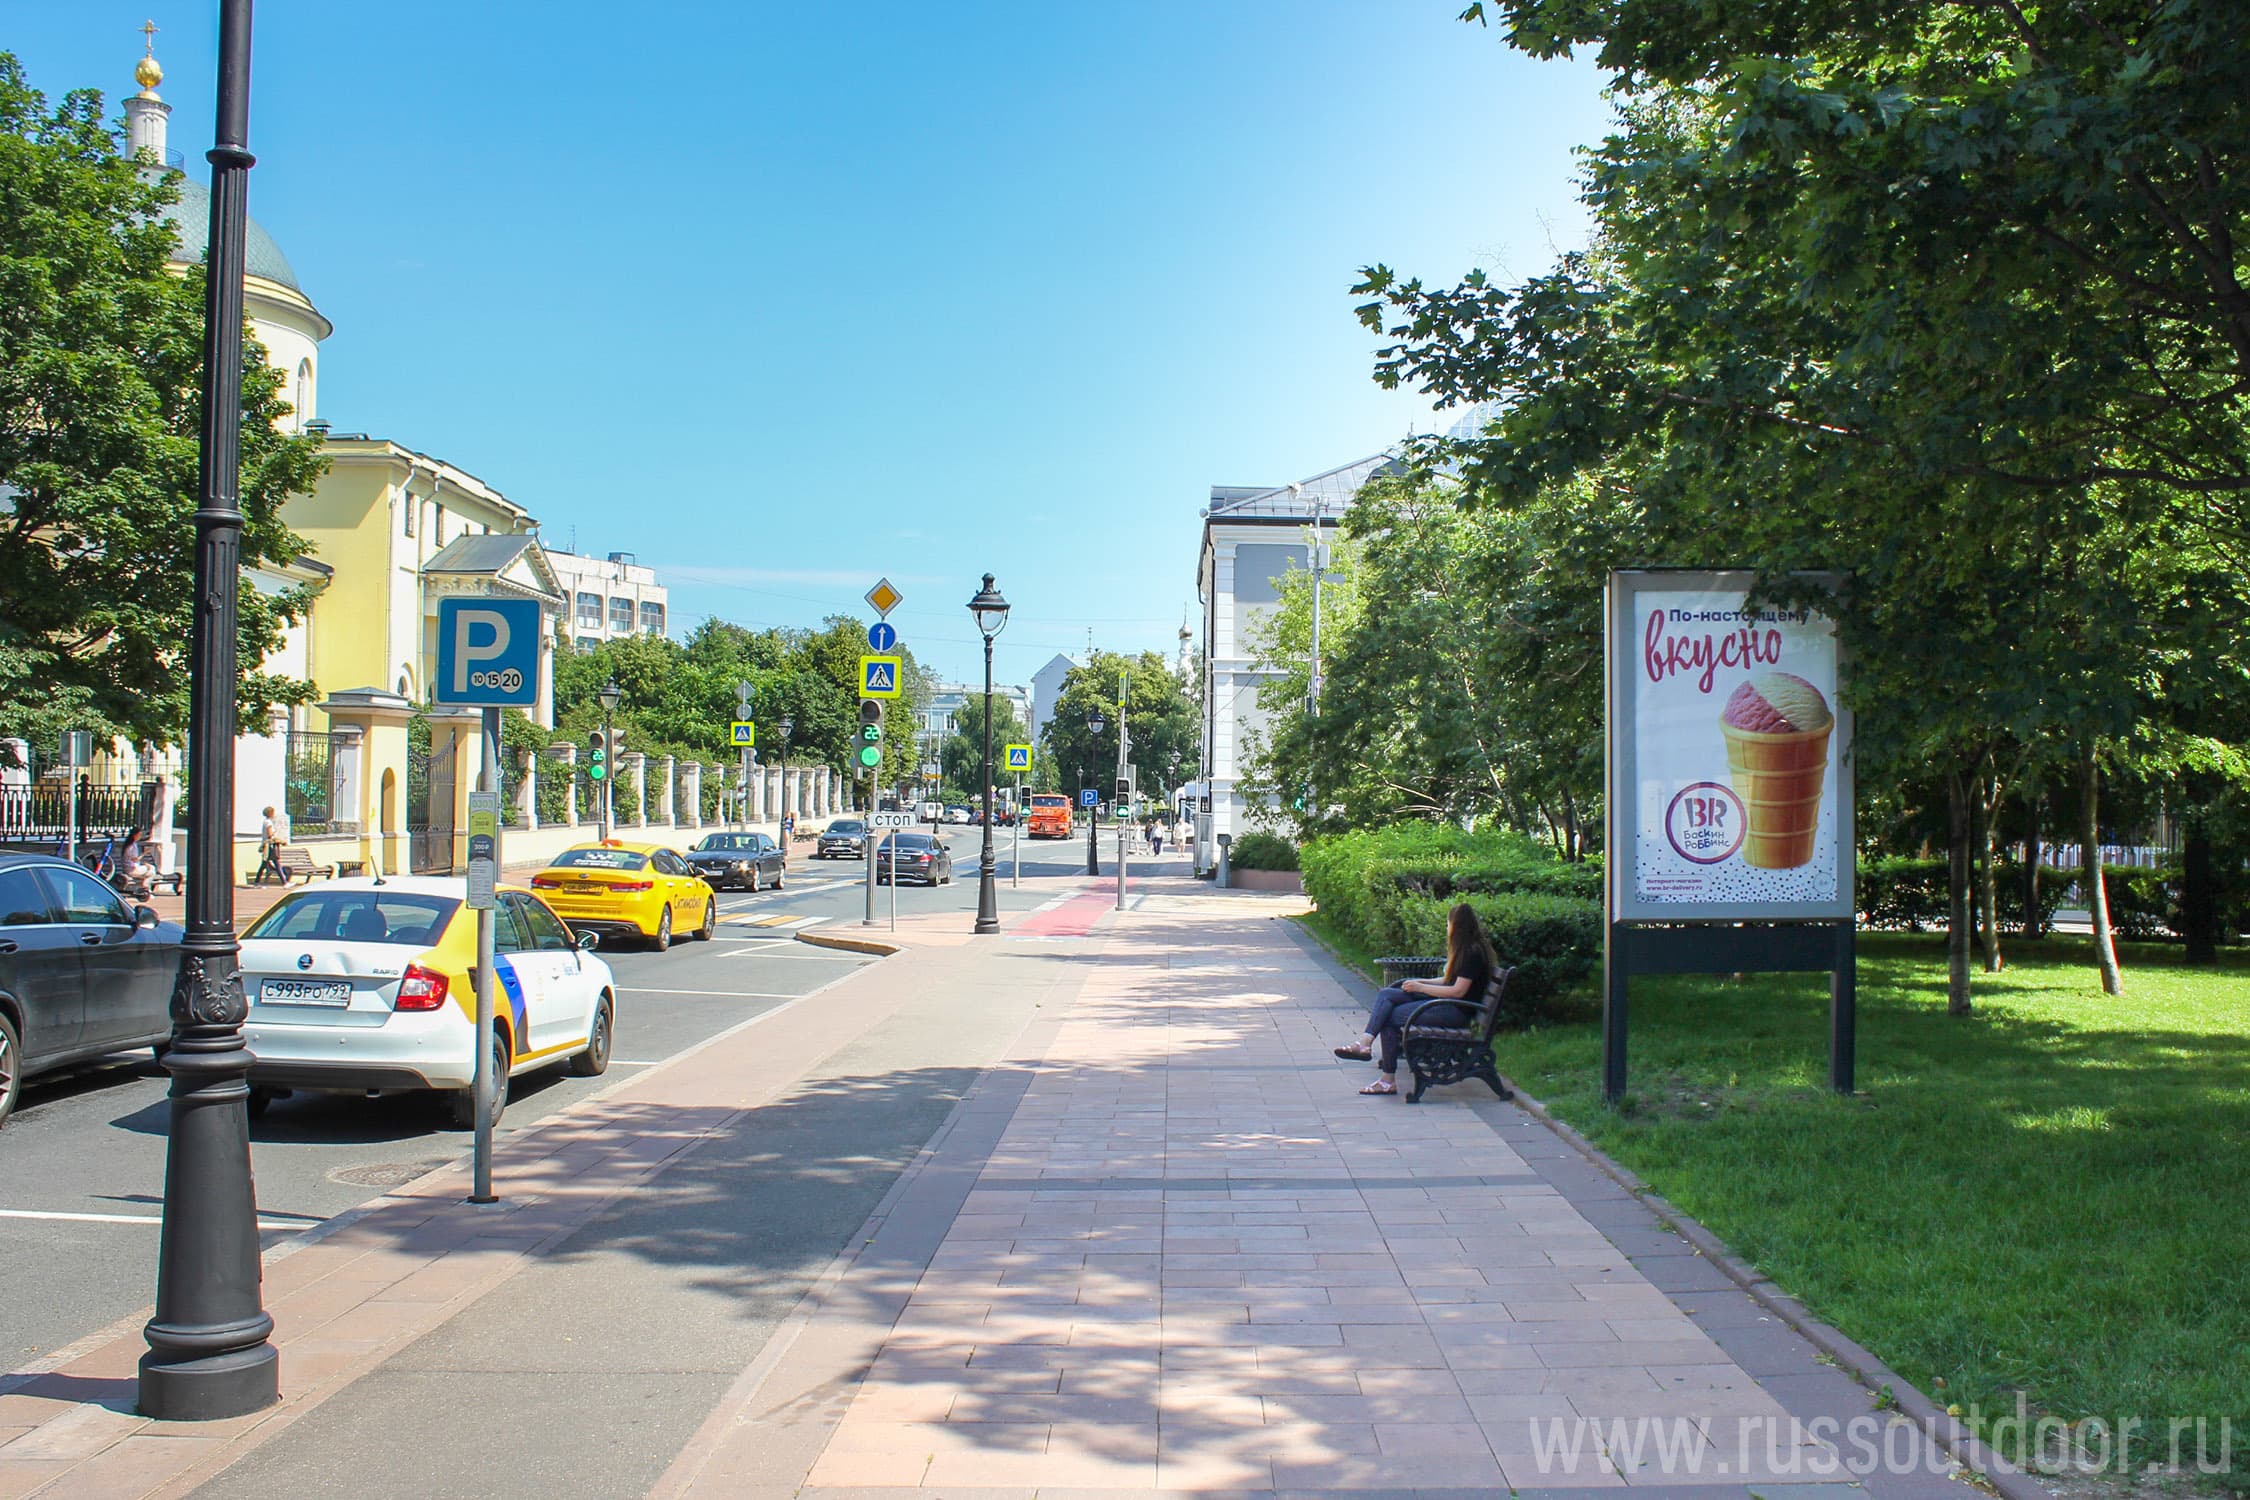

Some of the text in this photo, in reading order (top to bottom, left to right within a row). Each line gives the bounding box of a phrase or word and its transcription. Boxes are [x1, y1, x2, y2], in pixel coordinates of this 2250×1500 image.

[453, 609, 511, 693] P
[1645, 609, 1782, 694] вкусно
[473, 673, 520, 687] 10 15 20
[864, 726, 880, 740] 22
[1085, 791, 1094, 804] P
[1684, 797, 1728, 828] BR
[875, 815, 910, 826] СТОП
[372, 968, 399, 976] RAPID
